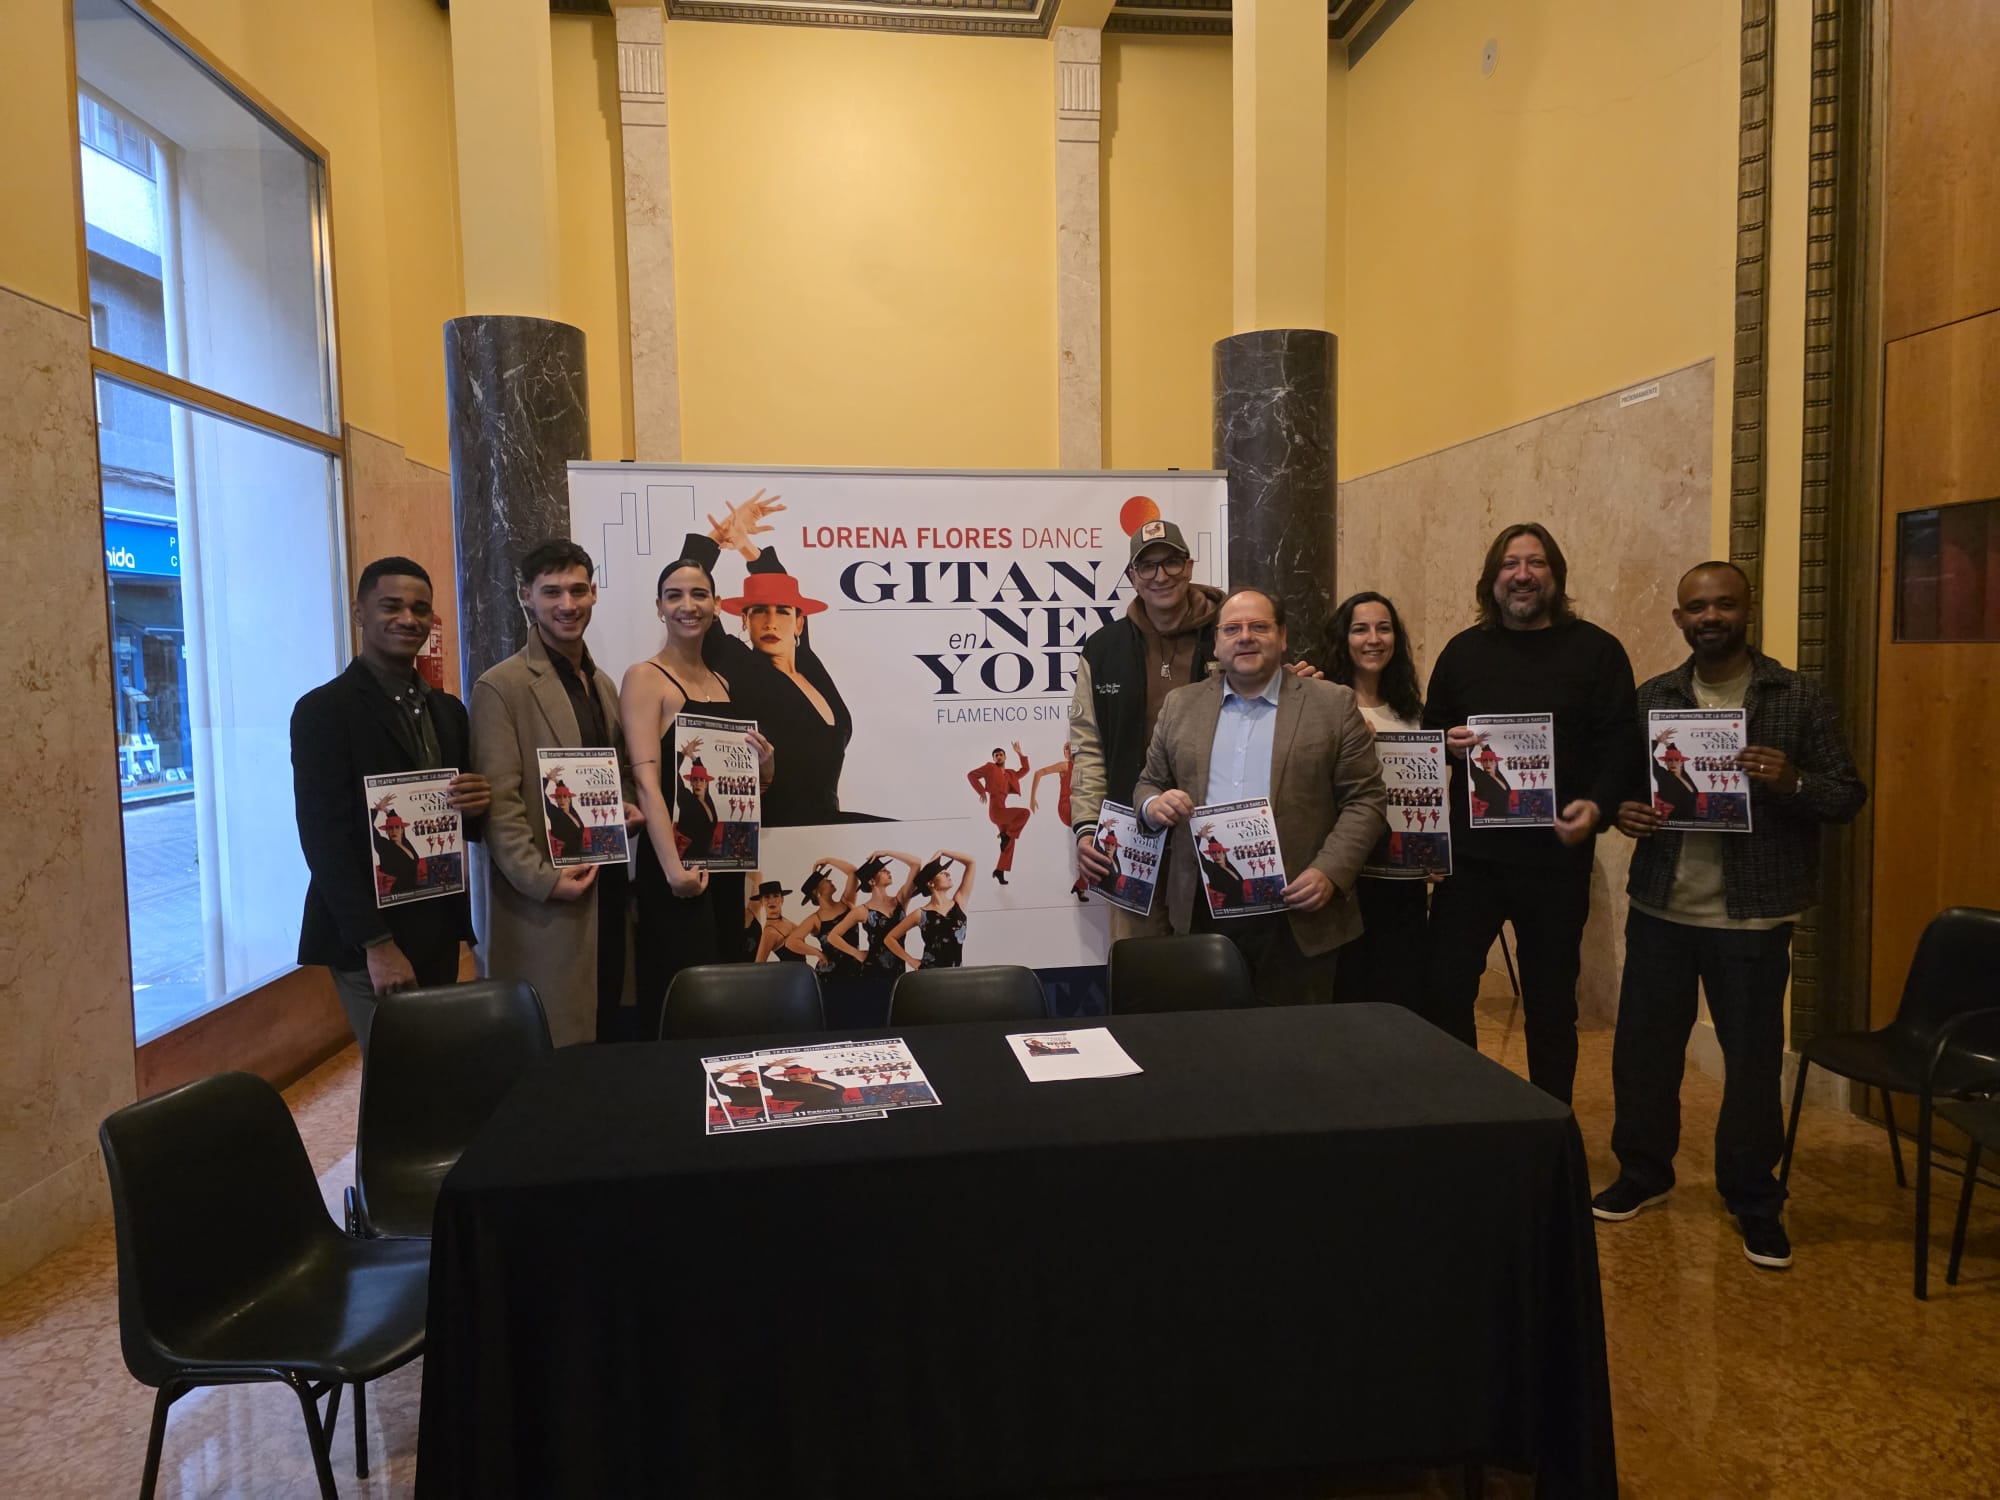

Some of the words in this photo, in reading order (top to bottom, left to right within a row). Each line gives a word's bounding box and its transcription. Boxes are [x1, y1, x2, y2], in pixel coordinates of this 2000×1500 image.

[802, 526, 908, 548] LORENA
[917, 527, 1013, 549] FLORES
[1023, 528, 1103, 548] DANCE
[949, 632, 977, 650] en
[914, 651, 1083, 695] YOR
[937, 706, 1028, 724] FLAMENCO
[1033, 705, 1060, 721] SIN
[715, 744, 752, 754] GITANA
[730, 753, 752, 761] NEW
[1382, 756, 1439, 765] GITANA
[723, 759, 753, 769] YORK
[1406, 764, 1438, 772] NEW
[576, 767, 614, 775] GITANA
[1395, 771, 1439, 780] YORK
[1226, 817, 1269, 829] GITANA
[1238, 828, 1271, 839] YORK
